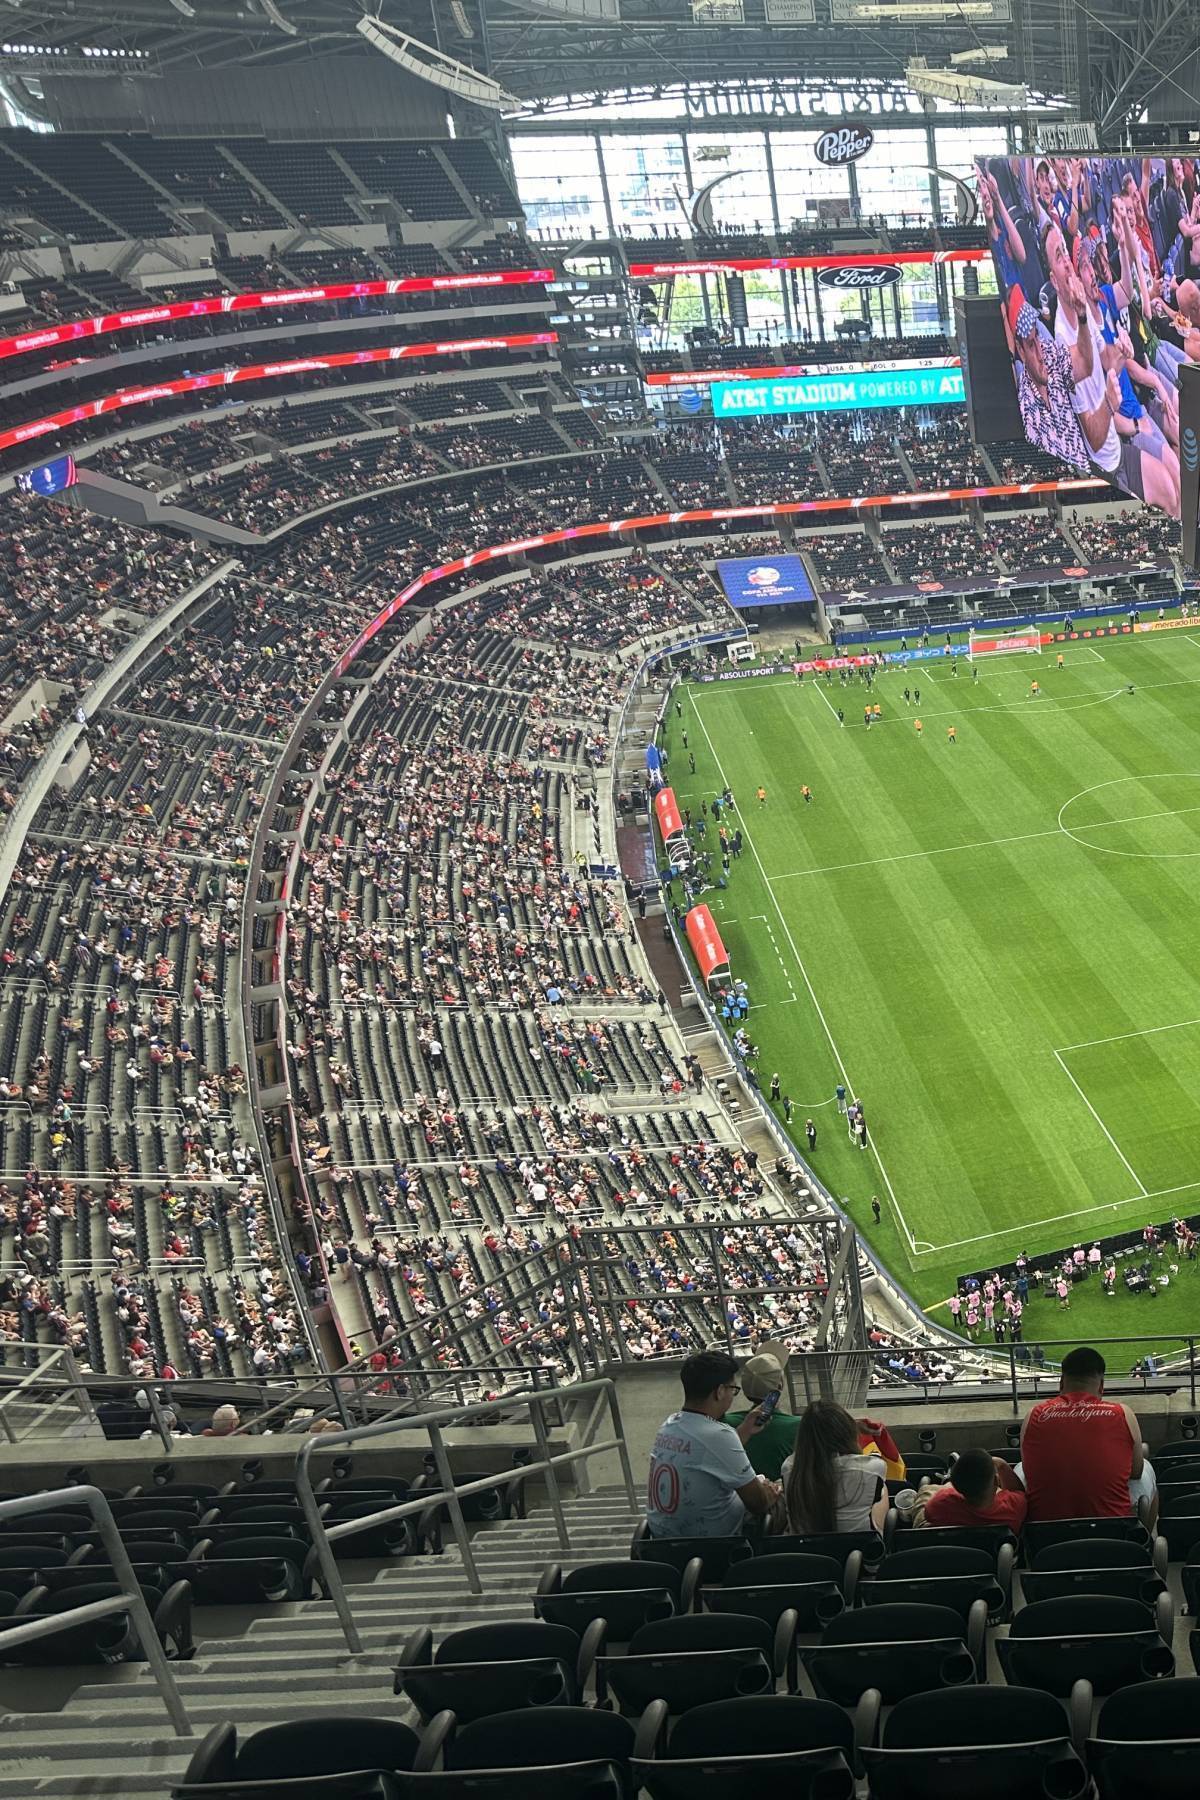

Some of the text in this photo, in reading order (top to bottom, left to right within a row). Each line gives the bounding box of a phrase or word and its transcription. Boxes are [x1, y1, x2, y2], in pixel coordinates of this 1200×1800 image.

[838, 128, 859, 146] Dr
[816, 132, 872, 161] Pepper
[833, 266, 887, 288] Ford
[721, 386, 769, 410] AT&T
[772, 382, 855, 409] STADIUM
[859, 381, 917, 399] POWERED
[920, 379, 936, 395] BY
[1155, 619, 1189, 629] mercado
[827, 657, 852, 669] TCL
[719, 670, 751, 680] ABSOLUT
[752, 667, 775, 677] SPORT
